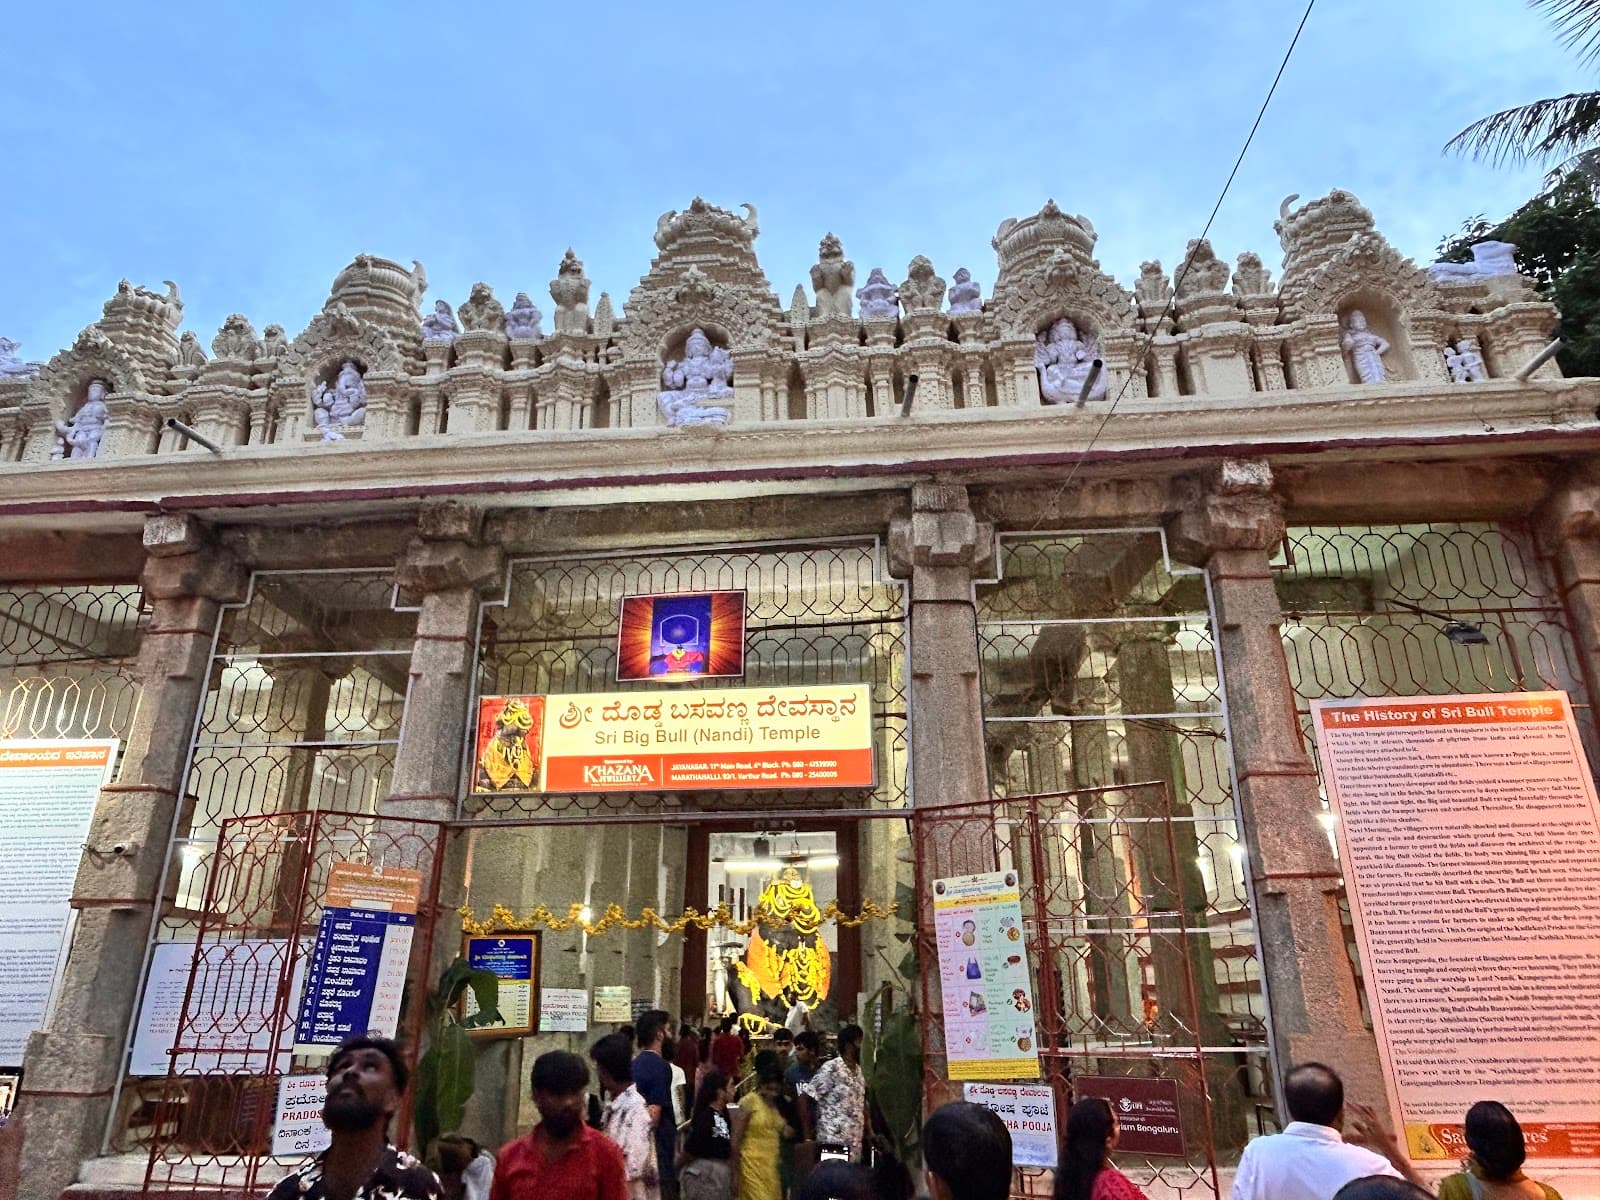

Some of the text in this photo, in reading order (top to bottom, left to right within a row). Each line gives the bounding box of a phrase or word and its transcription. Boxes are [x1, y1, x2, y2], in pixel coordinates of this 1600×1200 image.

[559, 693, 856, 729] ಶ್ರೀ ದೊಡ್ಡ ಬಸವಣ್ಣ ದೇವಸ್ಥಾನ
[1332, 704, 1554, 723] The History of Sri Bull Temple
[595, 726, 820, 746] Sri Big Bull (Nandi) Temple
[584, 764, 654, 783] KHAZANA
[282, 1110, 322, 1120] PRADOS
[1022, 1104, 1049, 1118] ಪೂಜೆ
[278, 1126, 311, 1138] ದಿನಾಂಕ
[1022, 1121, 1052, 1132] POOJA
[294, 1139, 310, 1150] ದಿನ
